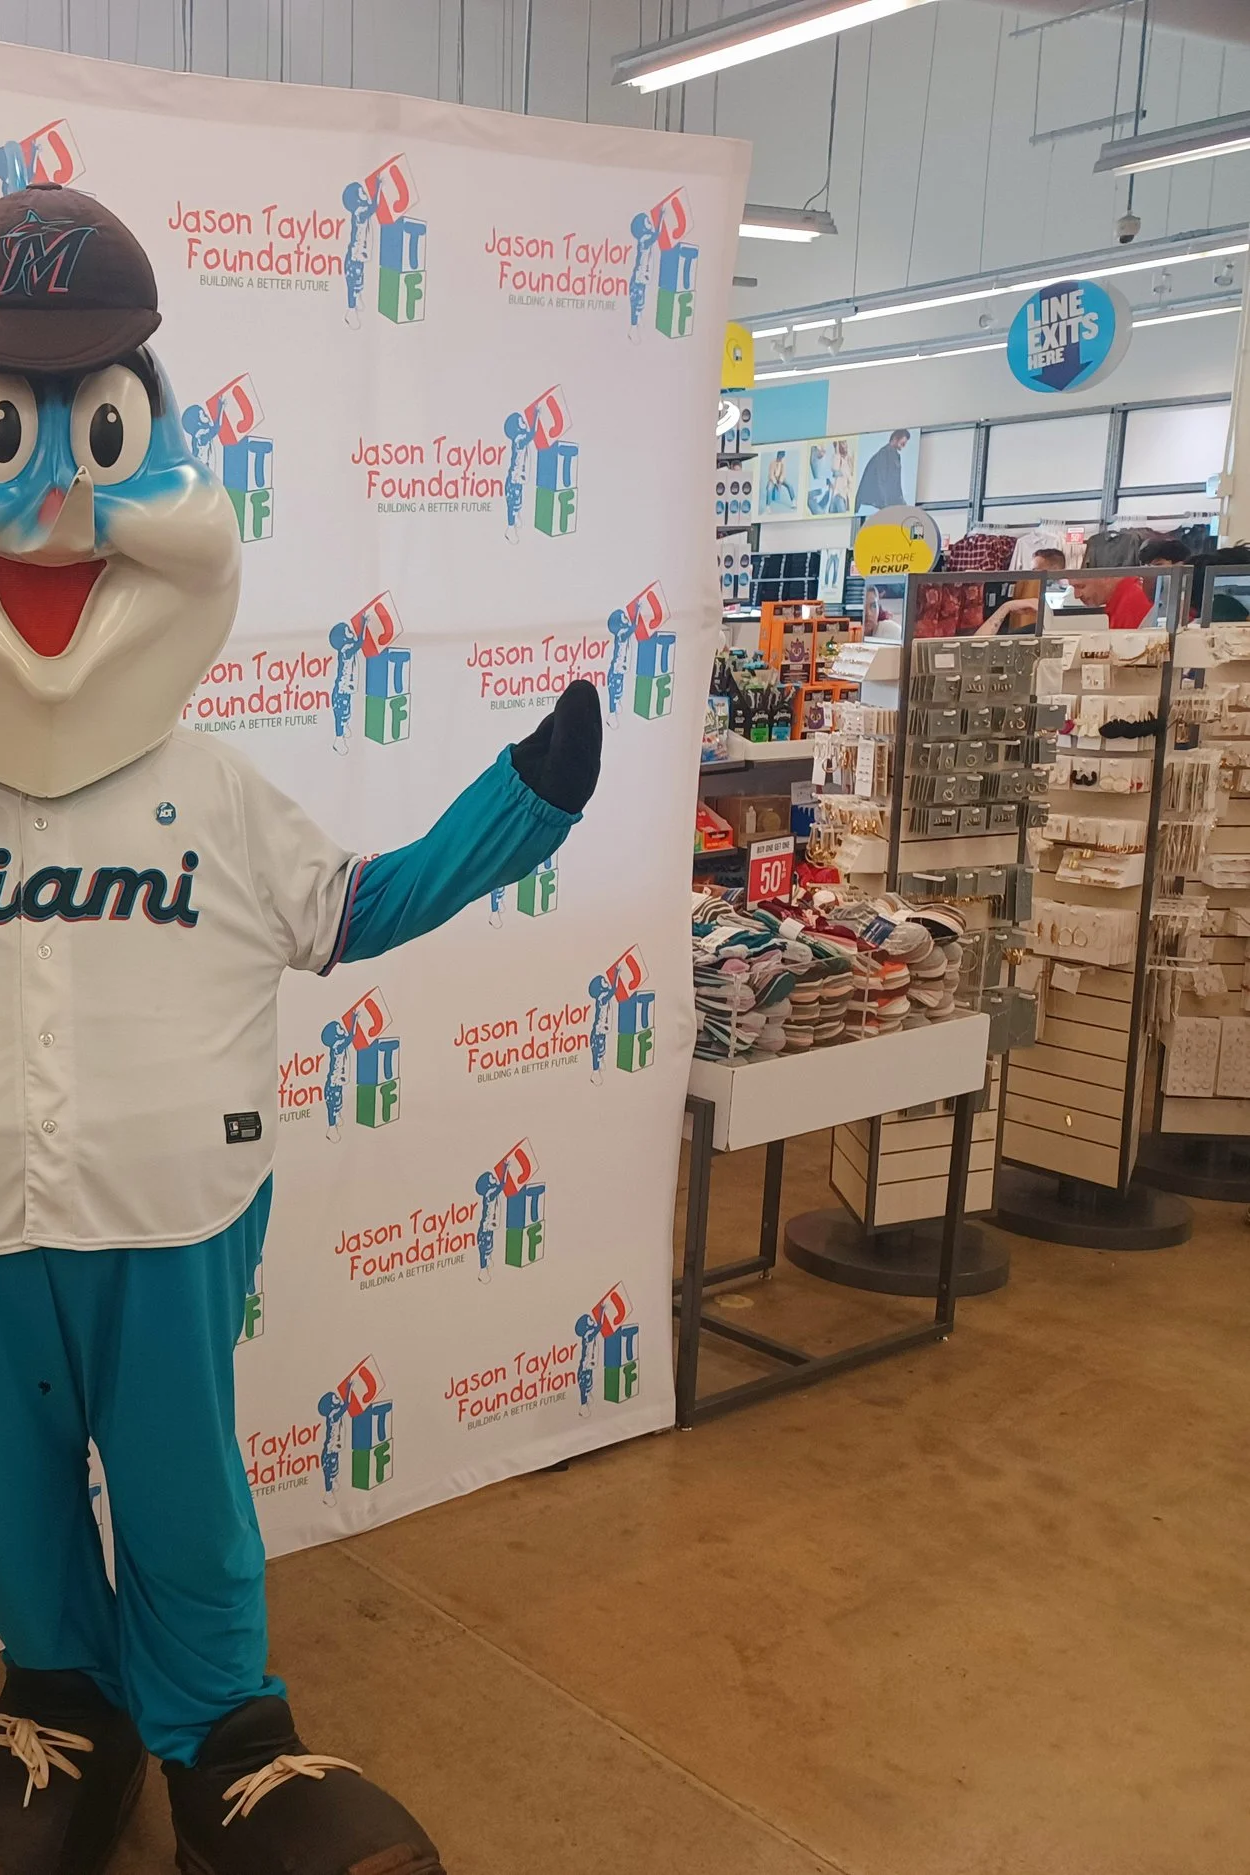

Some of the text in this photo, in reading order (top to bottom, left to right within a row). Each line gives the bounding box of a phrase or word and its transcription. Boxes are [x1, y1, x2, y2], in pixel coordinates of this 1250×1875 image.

[389, 164, 409, 214] J
[168, 199, 346, 247] Jason Taylor
[187, 237, 343, 276] Foundation
[402, 220, 427, 270] T
[484, 227, 632, 270] Jason Taylor
[199, 274, 330, 292] BUILDING A BETTER FUTURE
[404, 271, 423, 321] F
[498, 261, 628, 296] Foundation
[1026, 289, 1085, 329] LINE
[1027, 311, 1099, 356] EXITS
[1027, 347, 1065, 371] HERE
[351, 436, 507, 473] Jason Taylor
[367, 469, 504, 500] Foundation
[377, 502, 492, 513] BUILDING A BETTER FUTURE
[251, 651, 333, 687] Taylor
[466, 635, 610, 668] Jason Taylor
[238, 719, 246, 730] A
[248, 717, 282, 729] BETTER
[284, 714, 318, 727] FUTURE
[489, 697, 534, 710] BUILDING A
[453, 1003, 591, 1046] Jason Taylor
[468, 1031, 589, 1073] Foundation
[477, 1054, 578, 1083] BUILDING A BETTER FUTURE
[279, 1108, 311, 1123] FUTURE
[335, 1201, 478, 1254] Jason Taylor
[350, 1231, 476, 1281] Foundation
[359, 1253, 465, 1289] BUILDING A BETTER FUTURE
[443, 1342, 578, 1398] Jason Taylor
[458, 1371, 576, 1421] Foundation
[468, 1391, 566, 1429] BUILDING A BETTER FUTURE
[248, 1422, 321, 1458] Taylor
[278, 1475, 309, 1492] FUTURE
